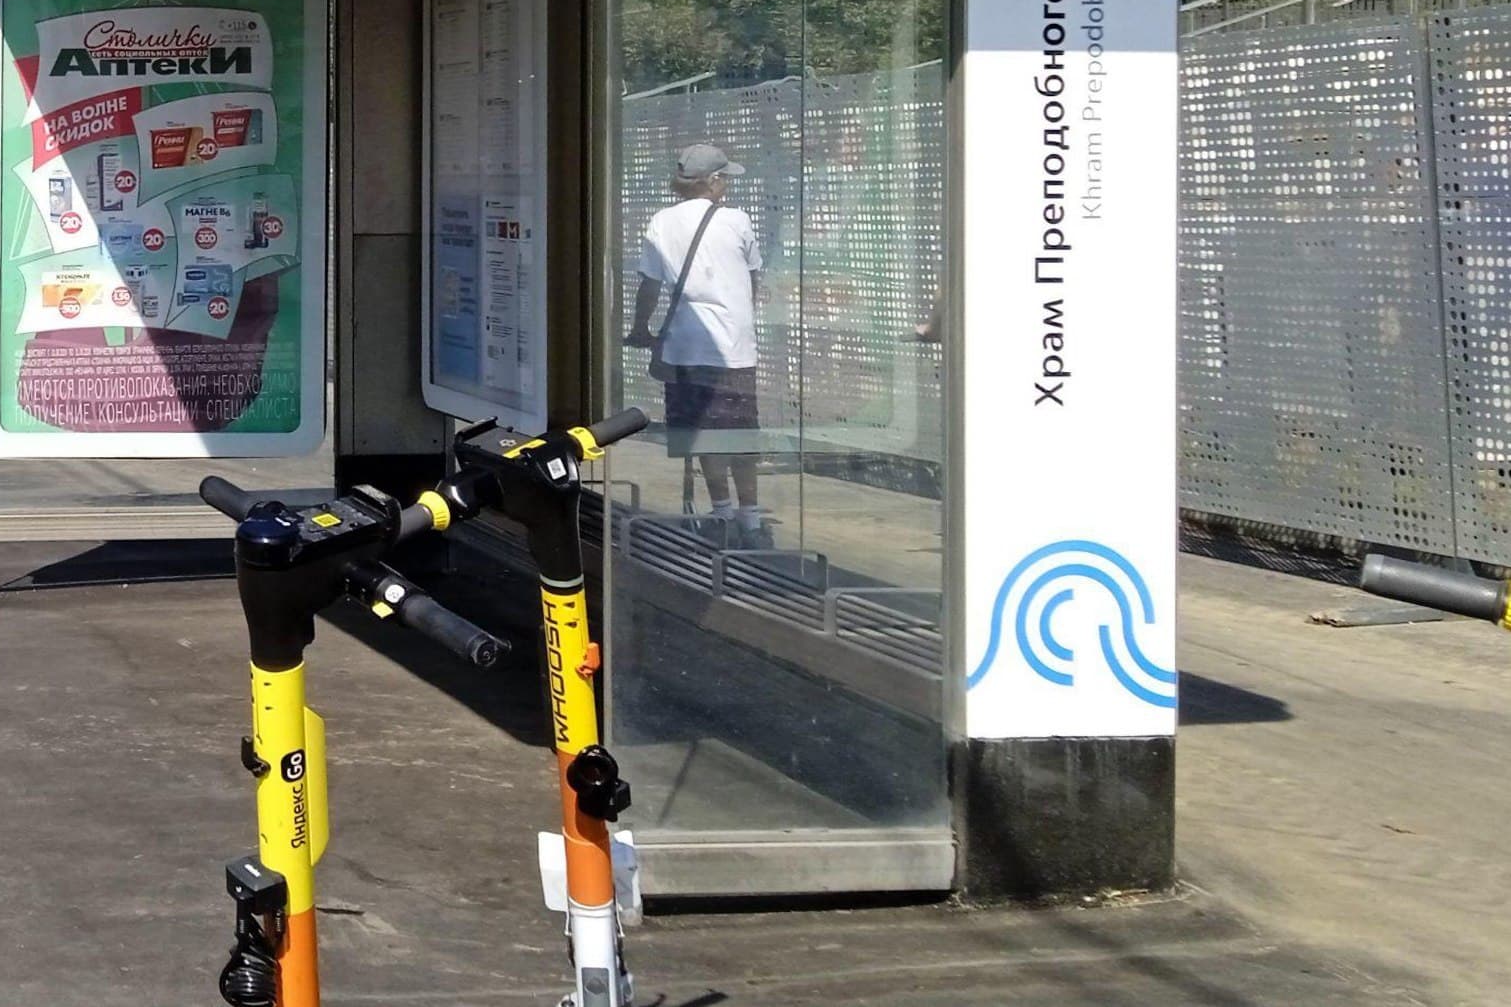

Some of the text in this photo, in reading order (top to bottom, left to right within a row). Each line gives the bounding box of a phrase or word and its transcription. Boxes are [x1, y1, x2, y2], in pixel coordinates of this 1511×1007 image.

[83, 20, 217, 49] Столички
[44, 95, 128, 135] НА ВОЛНЕ
[45, 117, 115, 151] СКИДОК
[1082, 132, 1103, 219] Khram
[1033, 298, 1072, 407] Храм
[15, 402, 90, 425] ПОЛУЧЕНИЕ
[99, 400, 199, 424] КОНСУЛЬТАЦИИ
[543, 601, 571, 743] WHOOSH
[286, 752, 306, 849] Яндекс Go
